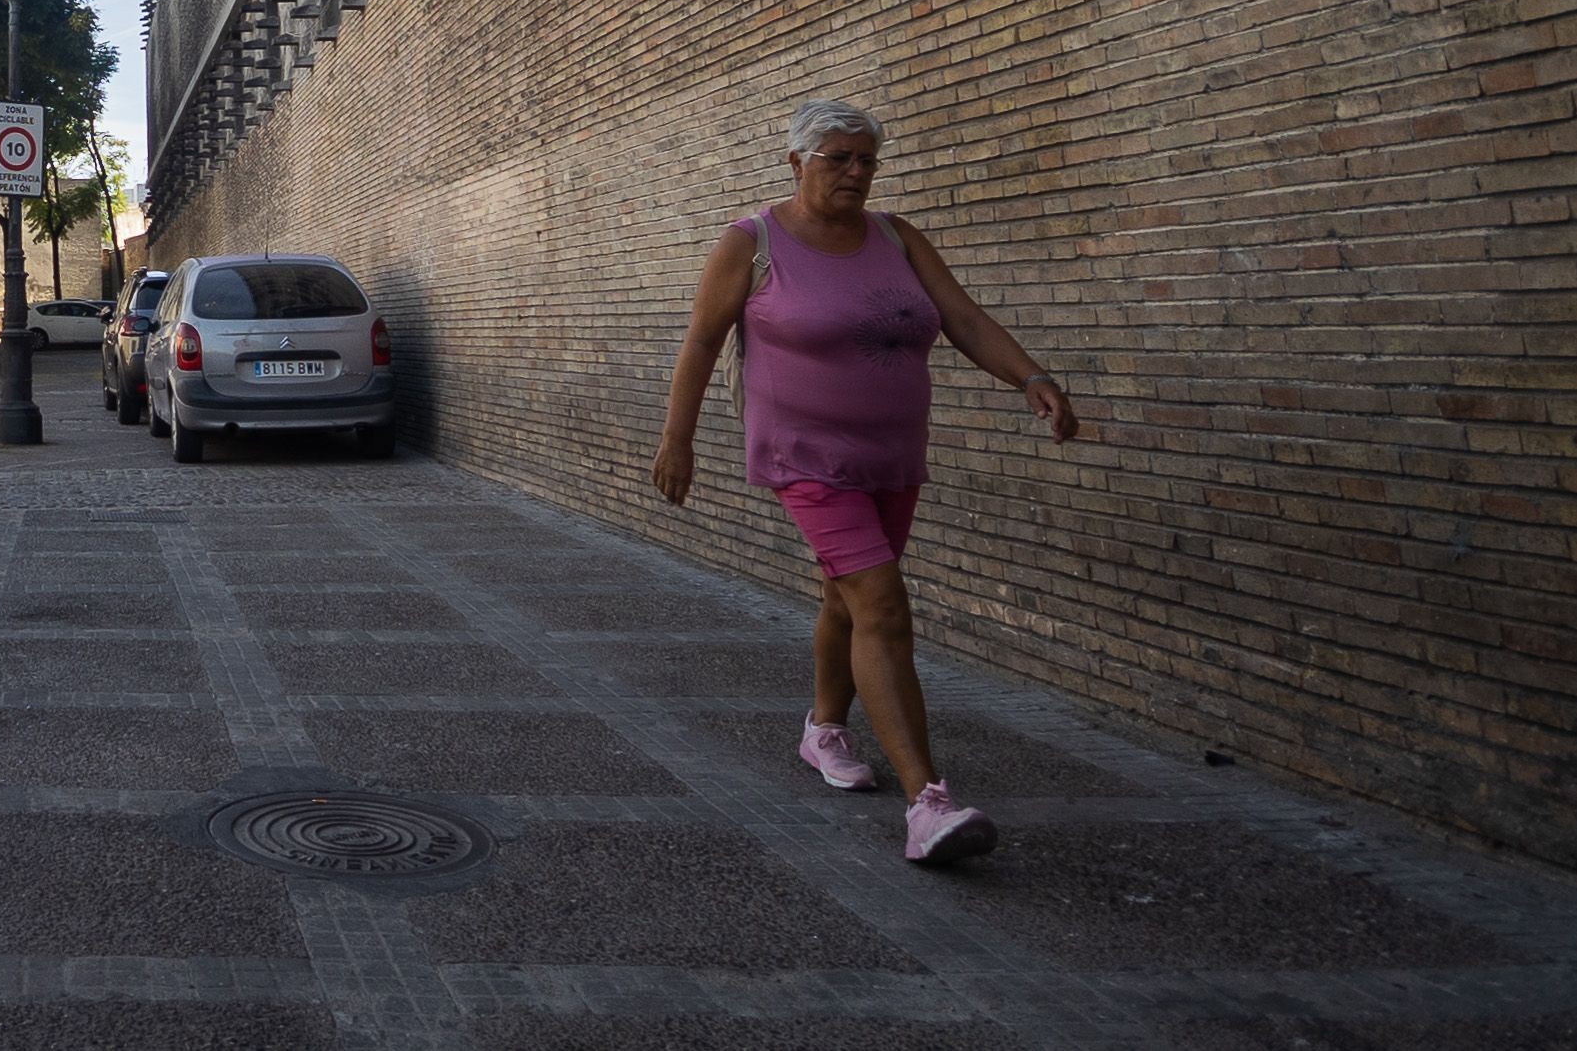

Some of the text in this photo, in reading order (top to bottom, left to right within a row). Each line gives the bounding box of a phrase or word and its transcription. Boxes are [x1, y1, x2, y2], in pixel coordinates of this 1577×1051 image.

[6, 105, 27, 114] ZONA
[6, 142, 25, 156] 10
[263, 362, 323, 375] 8115 BWM
